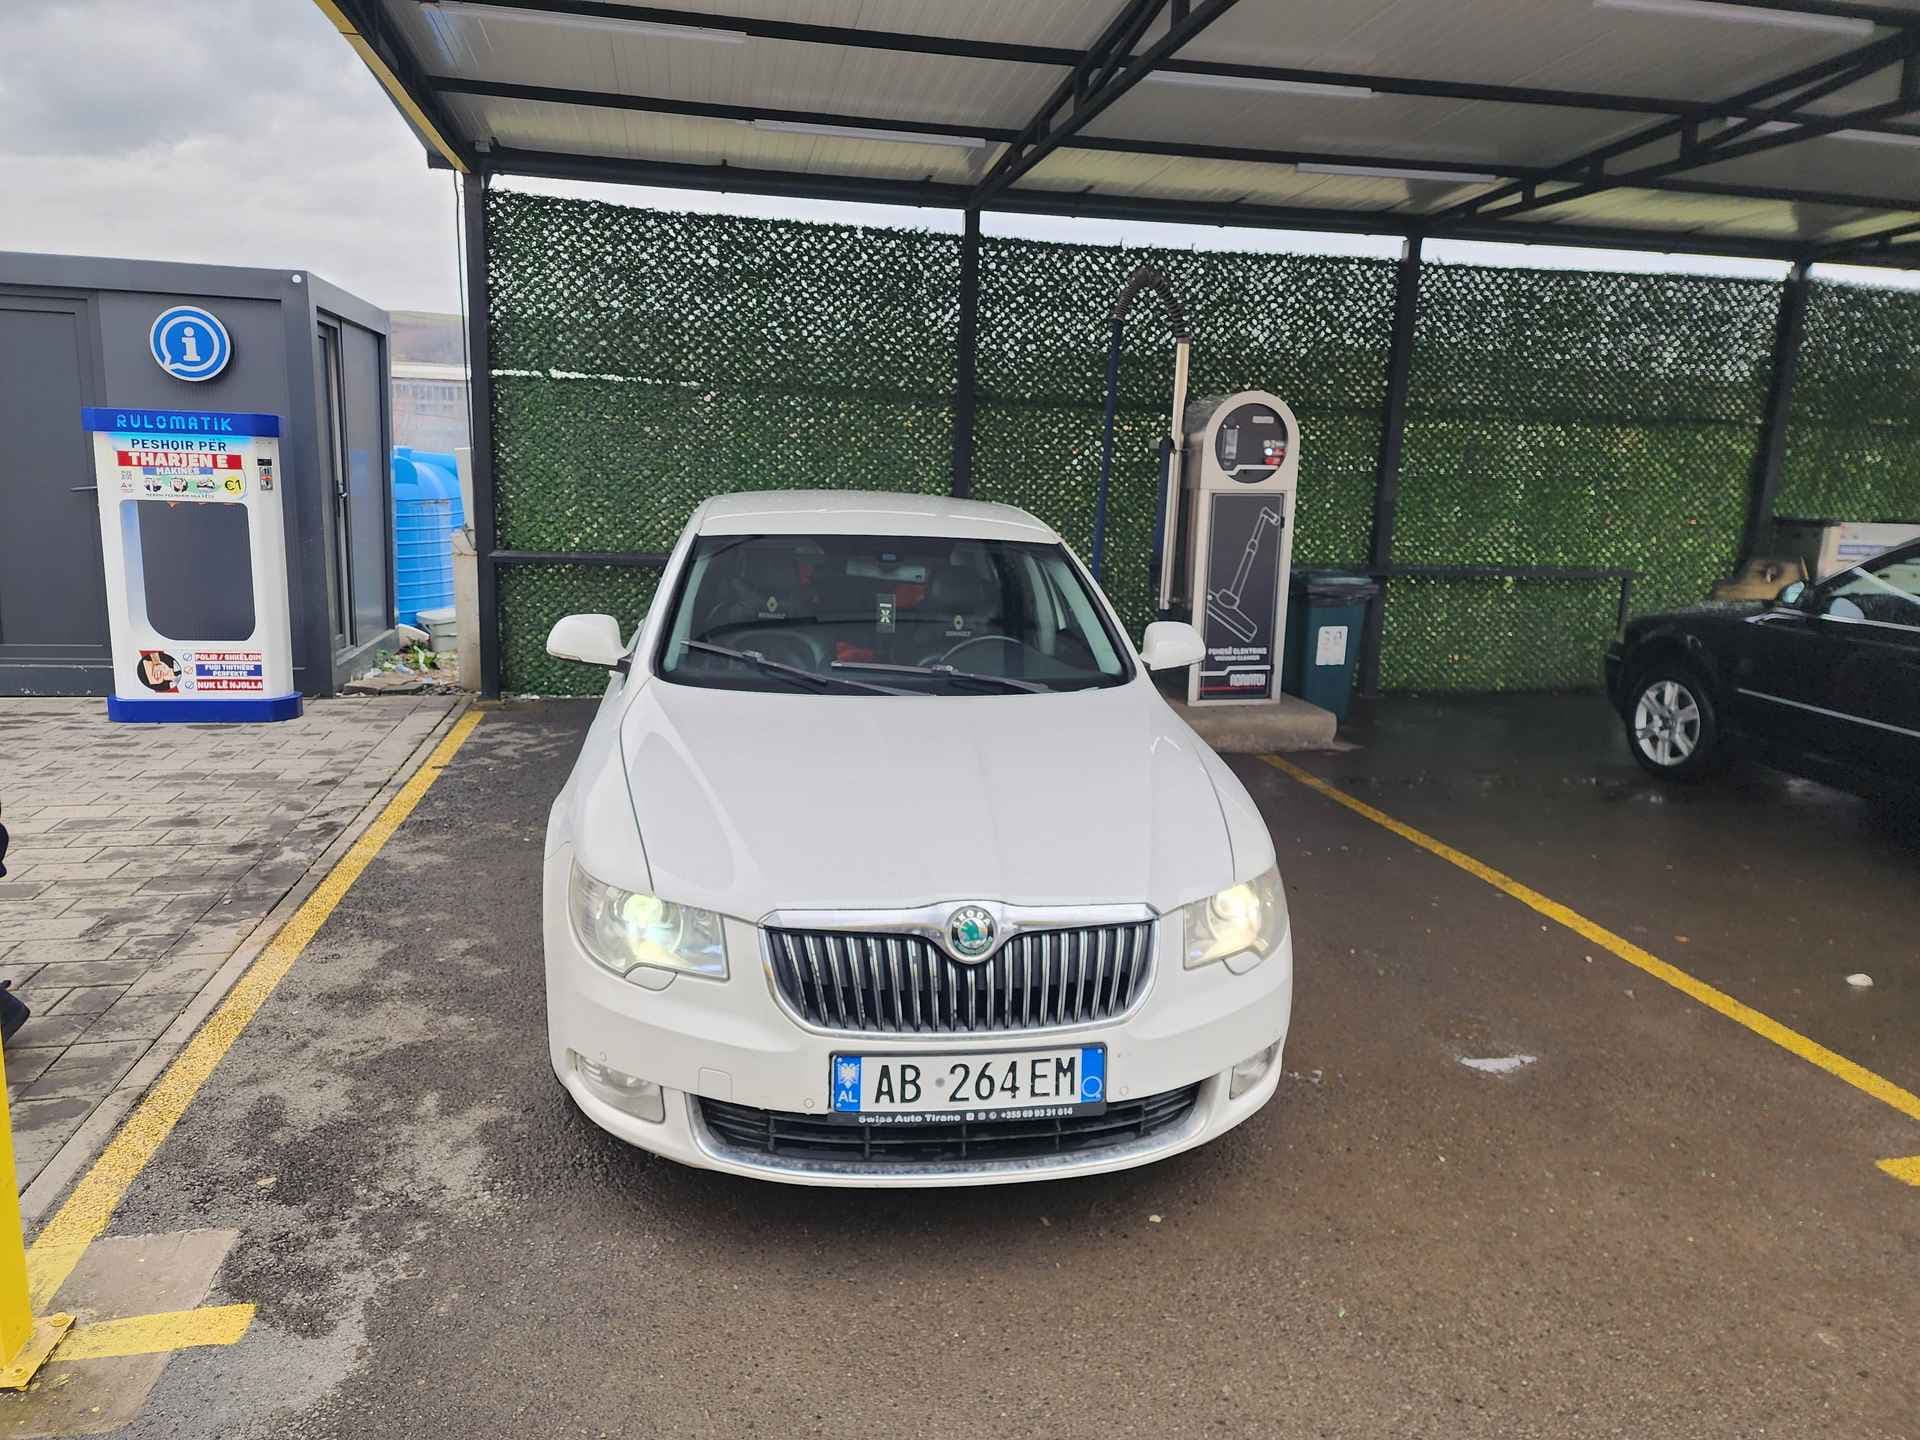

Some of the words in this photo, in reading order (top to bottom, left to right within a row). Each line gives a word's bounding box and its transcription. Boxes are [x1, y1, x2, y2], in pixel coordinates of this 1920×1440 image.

[116, 413, 233, 432] RULOMATIK
[874, 1063, 922, 1105] AB
[838, 1090, 858, 1103] AL
[895, 1113, 922, 1124] Auto
